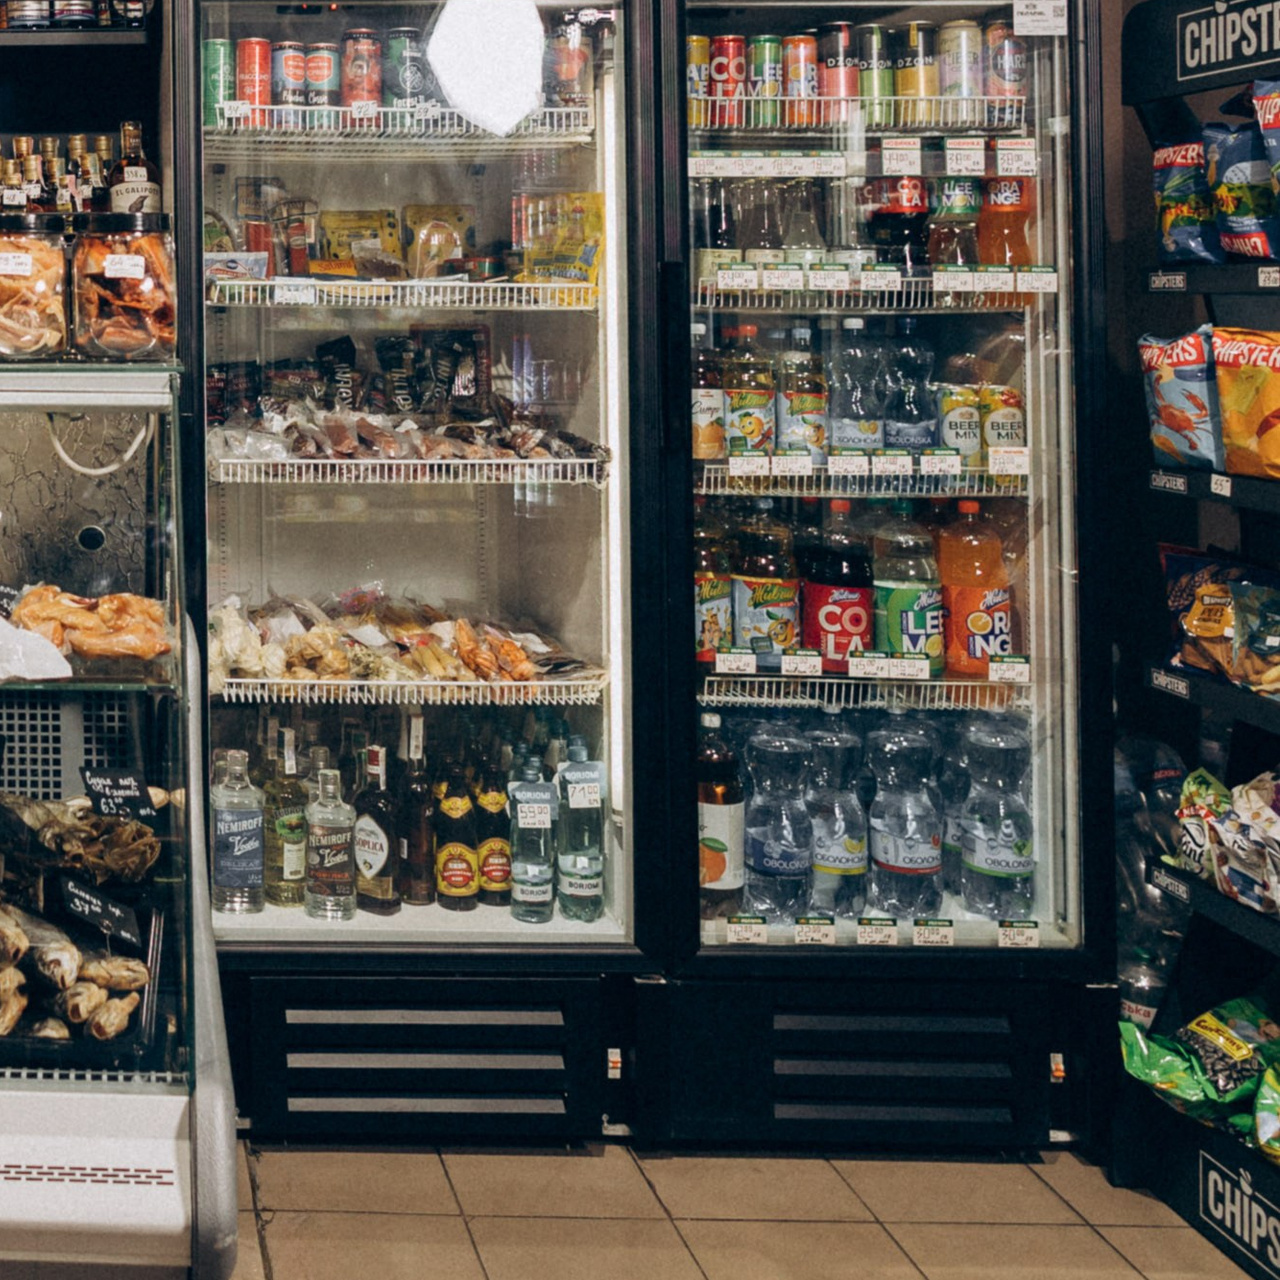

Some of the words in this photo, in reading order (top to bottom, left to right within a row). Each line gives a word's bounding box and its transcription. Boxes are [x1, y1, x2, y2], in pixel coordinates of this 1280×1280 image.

[711, 56, 746, 82] CO
[898, 180, 922, 193] CO
[902, 193, 922, 207] LA
[991, 193, 1022, 206] NGE
[1151, 274, 1186, 289] CHIPSTERS
[949, 420, 980, 431] BEER
[955, 430, 980, 441] MIX
[817, 605, 868, 635] CO
[216, 815, 264, 835] NEMIROFF
[308, 831, 353, 848] NEMIROFF
